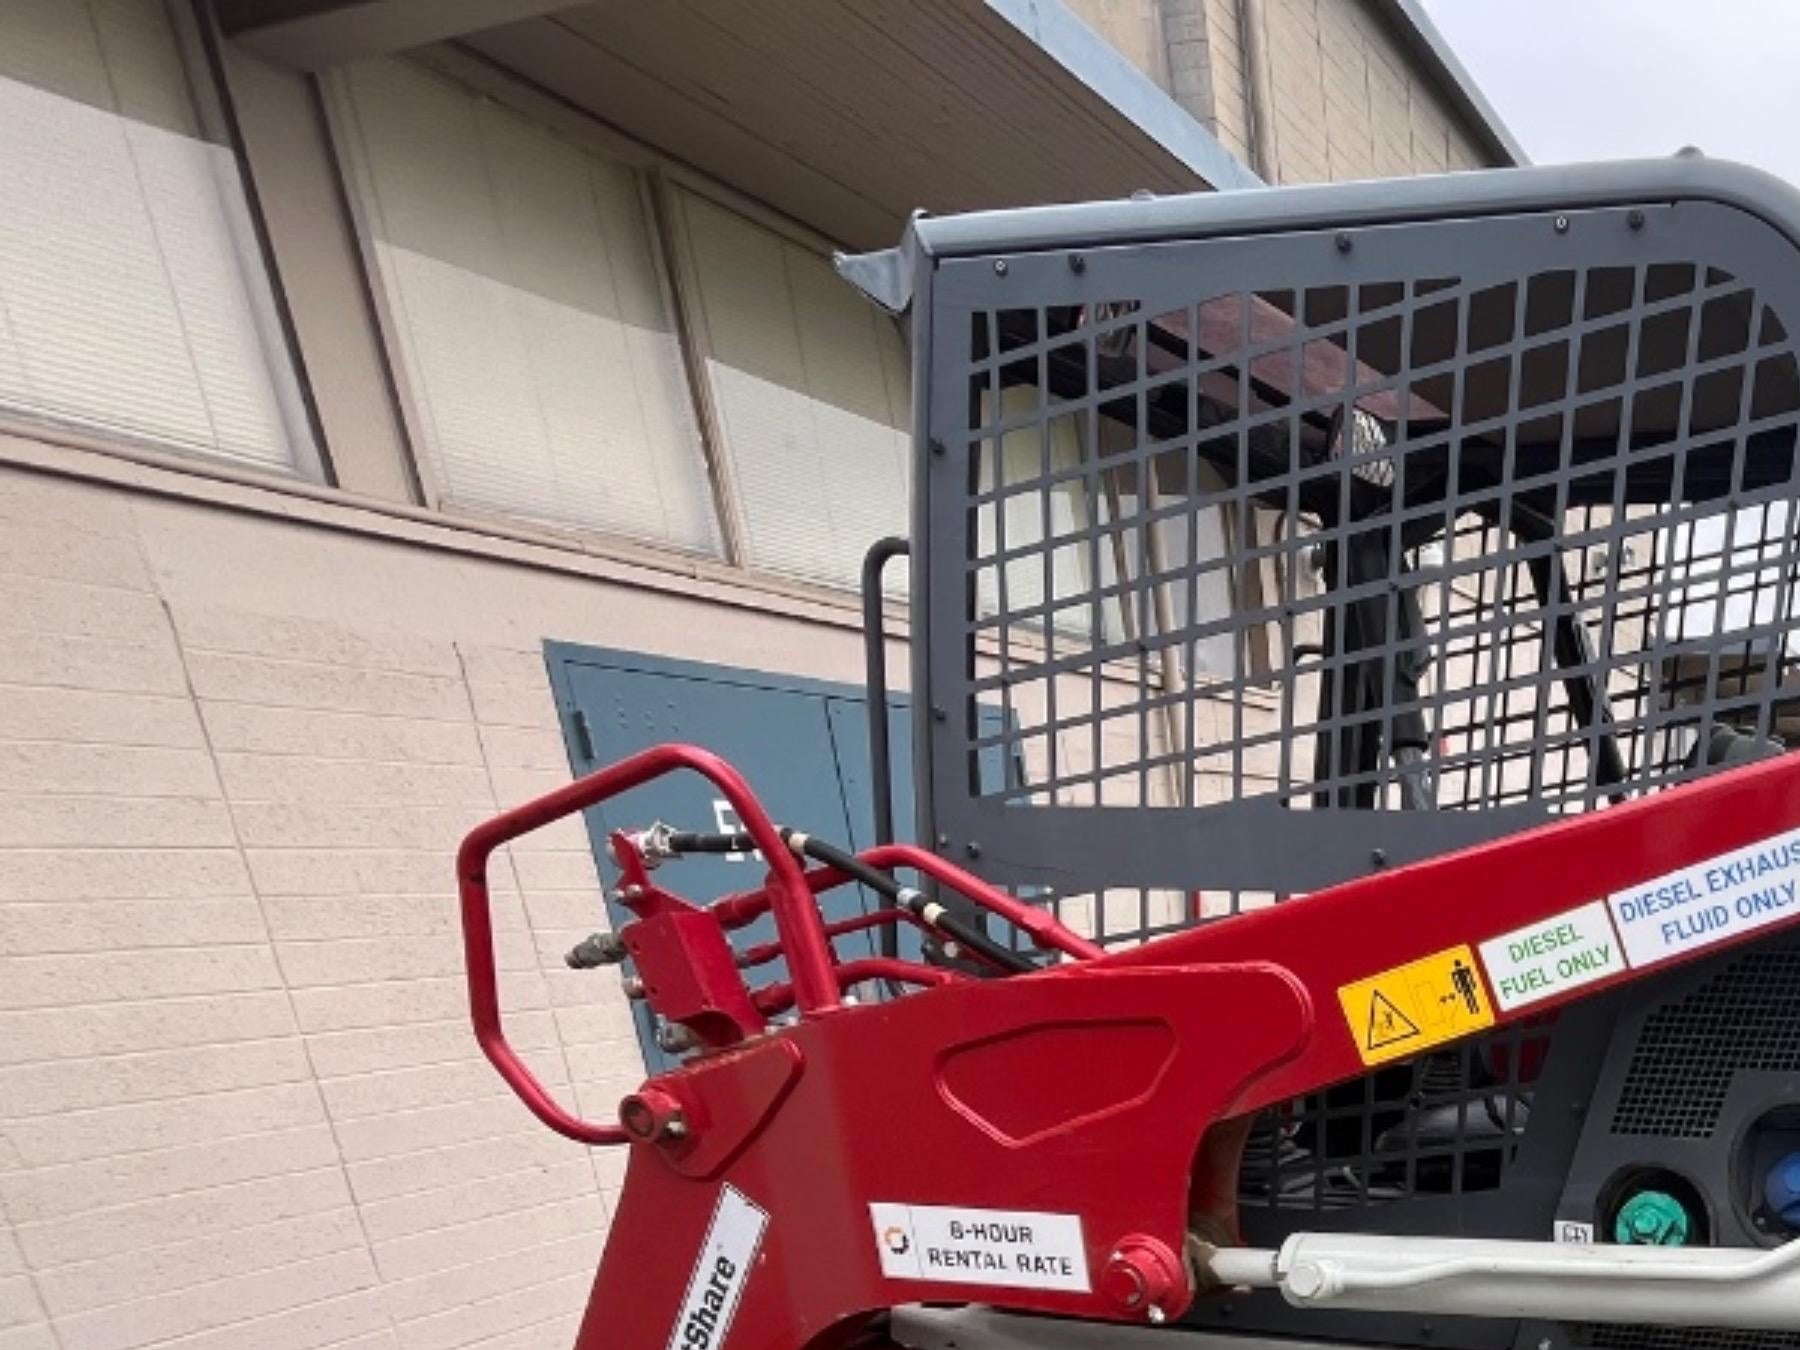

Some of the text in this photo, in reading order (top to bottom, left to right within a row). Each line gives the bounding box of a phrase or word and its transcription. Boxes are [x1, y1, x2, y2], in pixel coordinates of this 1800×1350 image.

[1619, 878, 1702, 922] DIESEL
[1661, 880, 1797, 945] FLUID ONLY
[1508, 923, 1584, 963] DIESEL
[1499, 944, 1610, 999] FUEL ONLY
[927, 1248, 1073, 1276] RENTAL RATE
